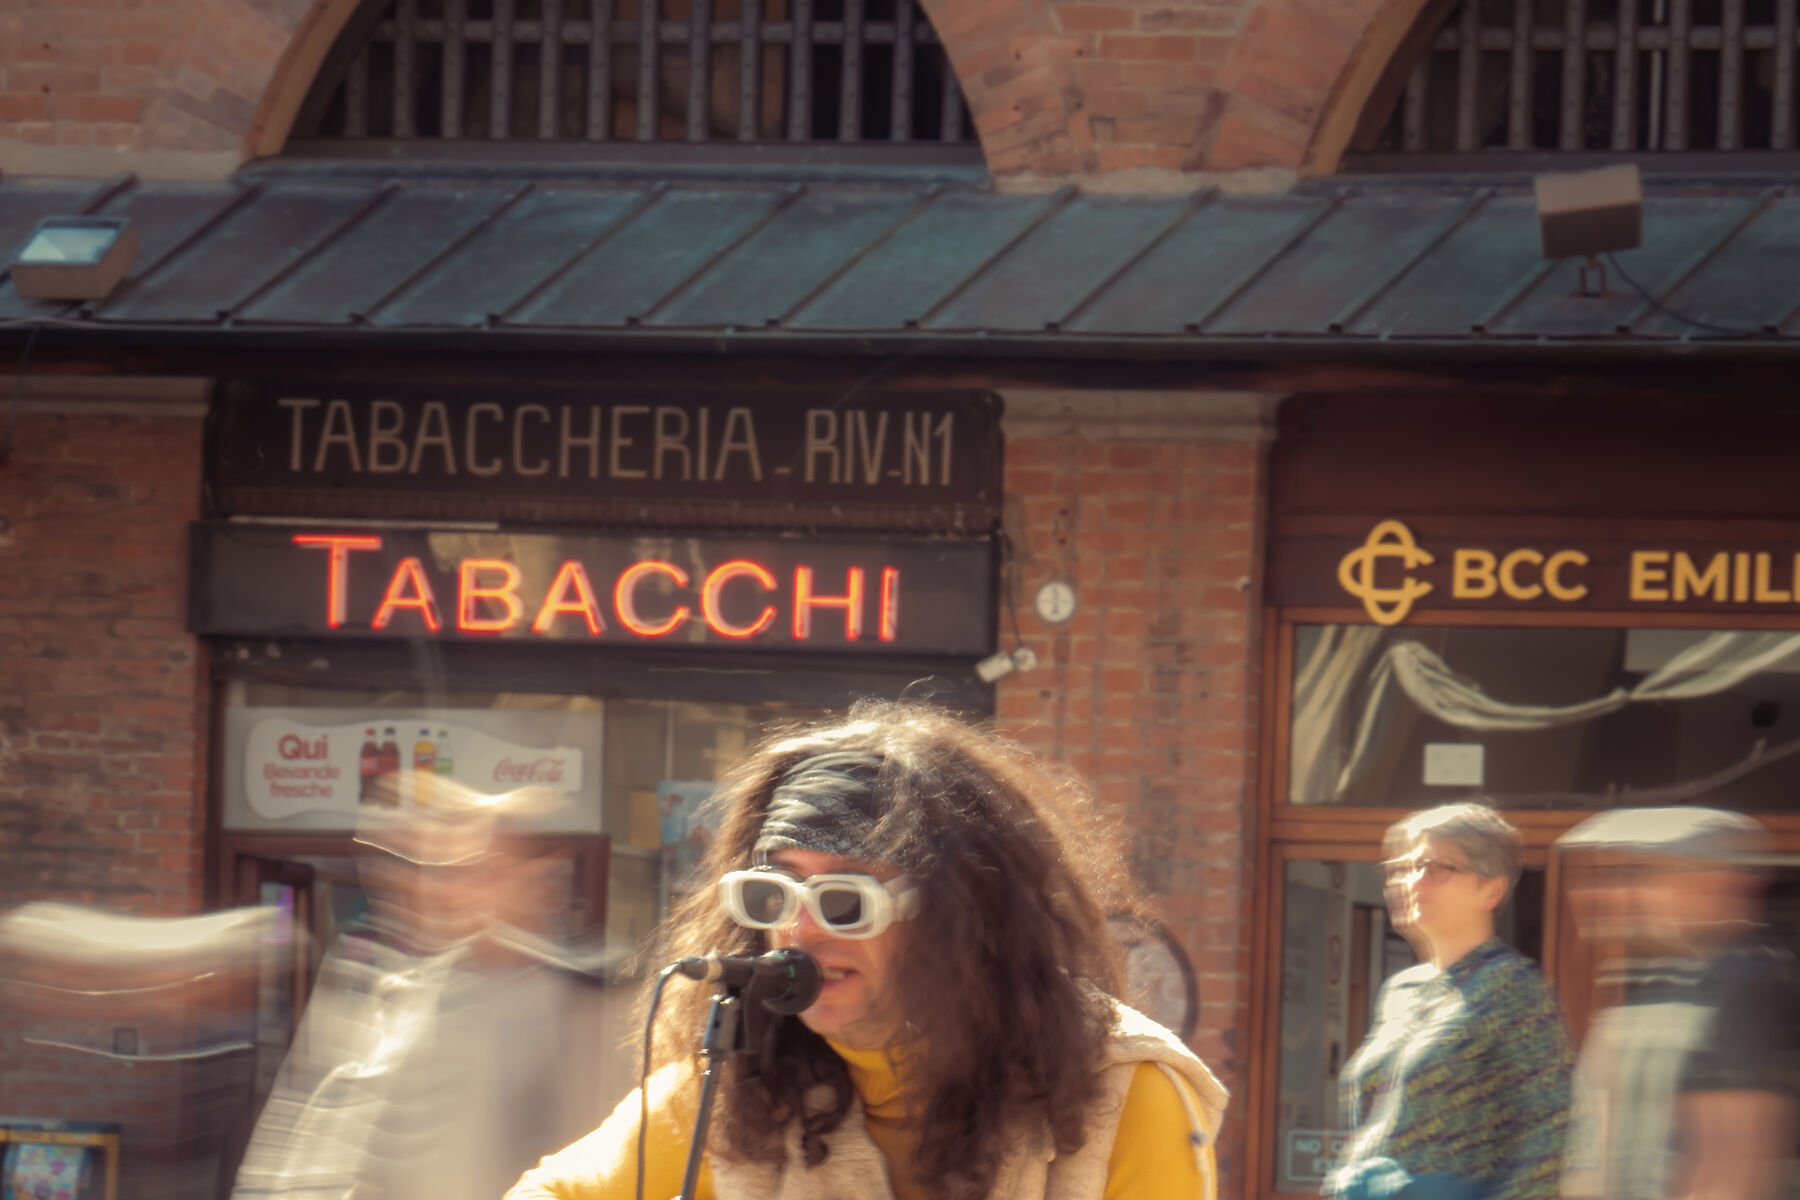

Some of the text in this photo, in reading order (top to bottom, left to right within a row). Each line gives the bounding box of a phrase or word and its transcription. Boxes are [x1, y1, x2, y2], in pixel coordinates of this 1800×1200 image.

[277, 398, 763, 483] TABACCHERIA
[291, 534, 899, 642] TABACCHI
[1452, 548, 1590, 601] BCC
[263, 761, 341, 780] Bevande
[277, 732, 329, 760] Qui
